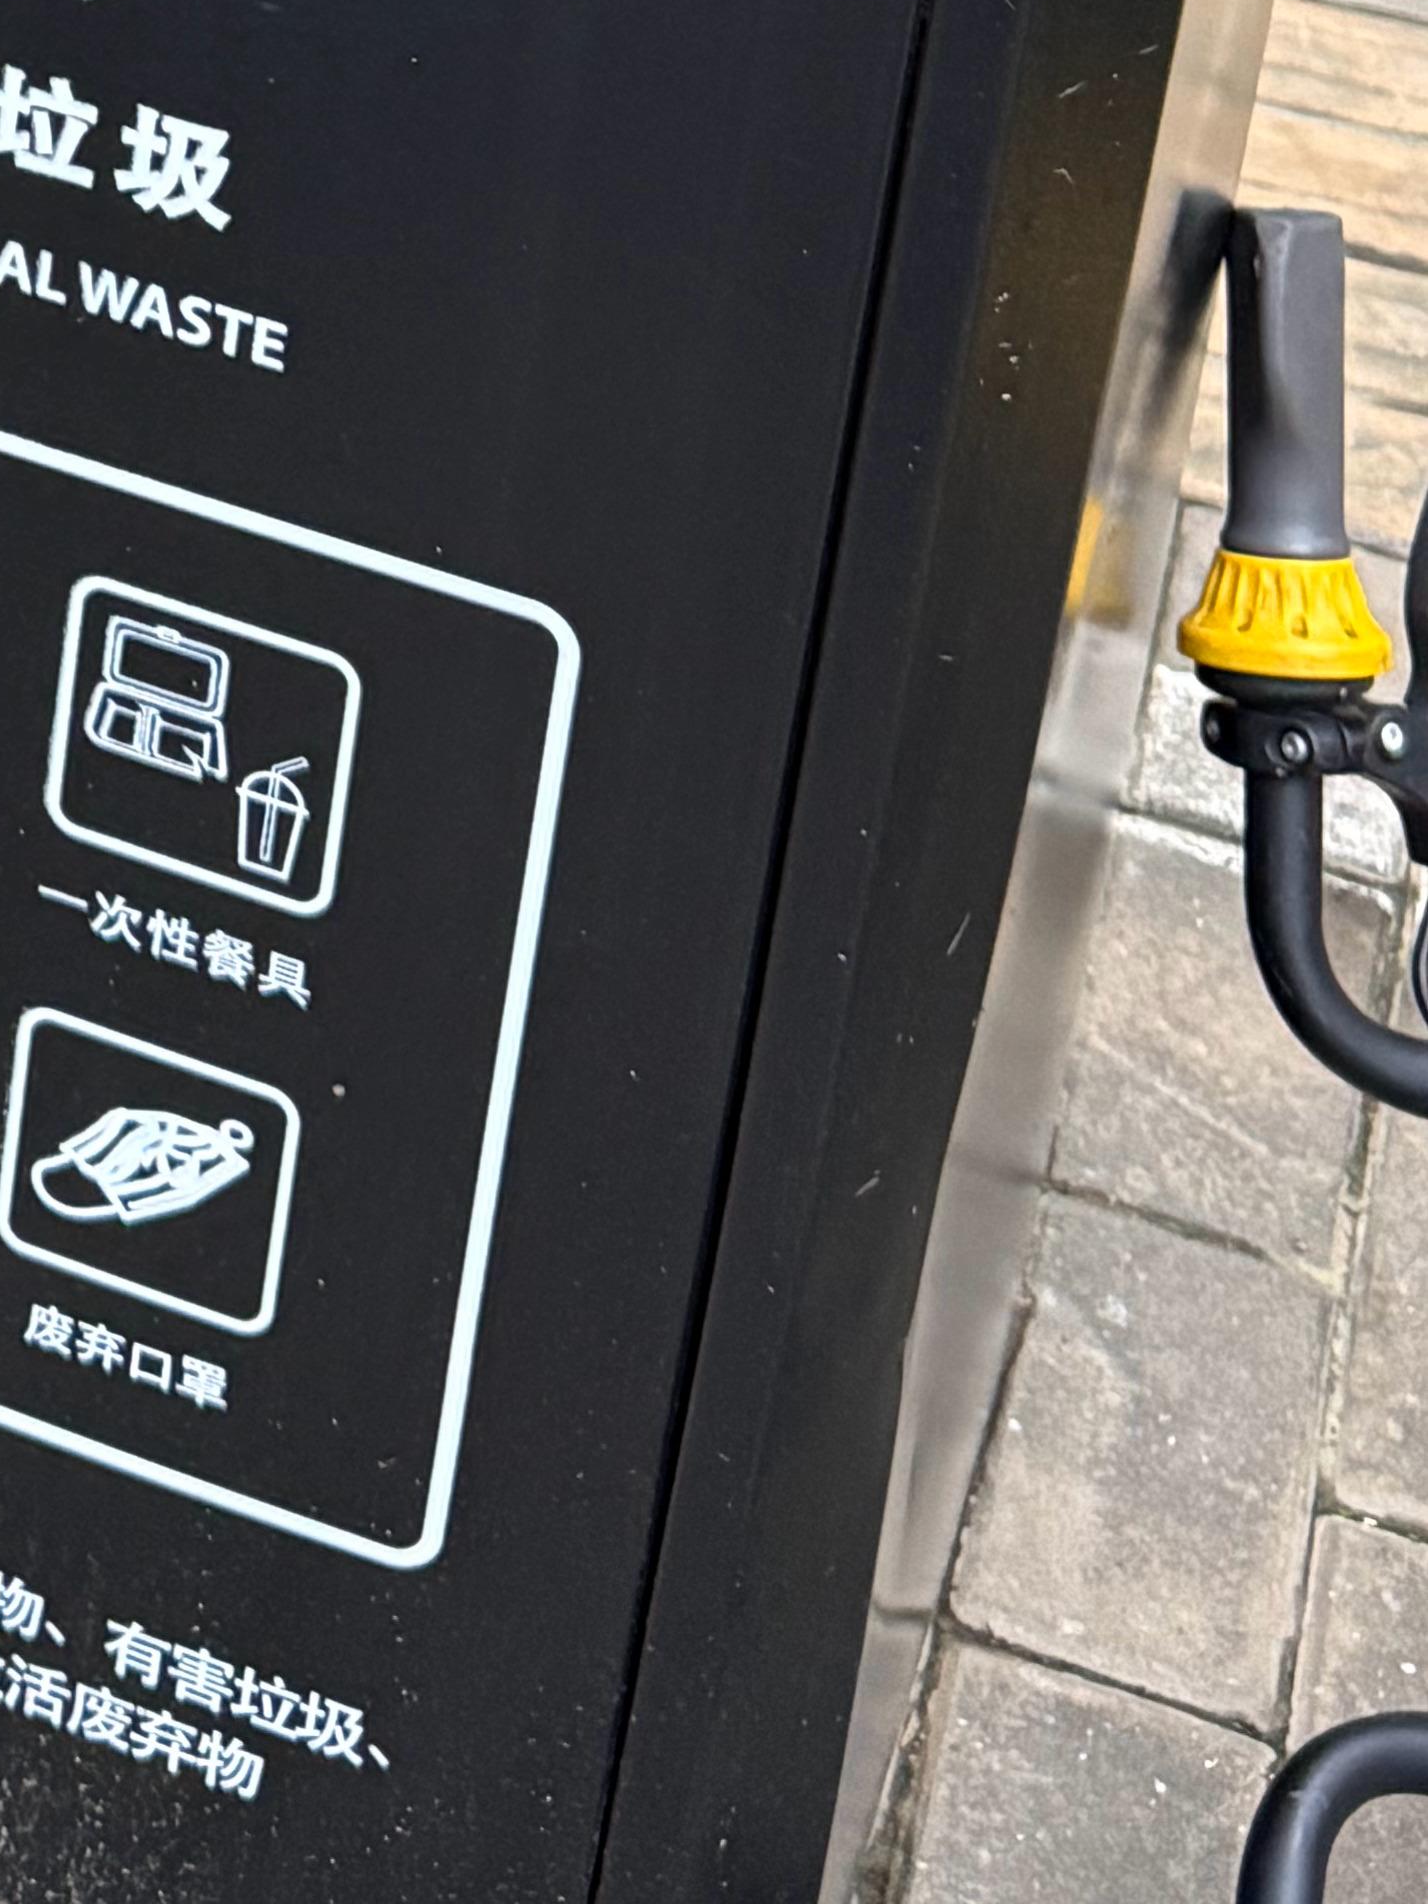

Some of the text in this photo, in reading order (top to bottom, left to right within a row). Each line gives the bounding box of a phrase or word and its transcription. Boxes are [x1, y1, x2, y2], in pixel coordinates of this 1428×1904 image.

[78, 260, 289, 373] WASTE
[37, 883, 312, 1008] 一次性餐具
[22, 1302, 229, 1410] 废弃口罩
